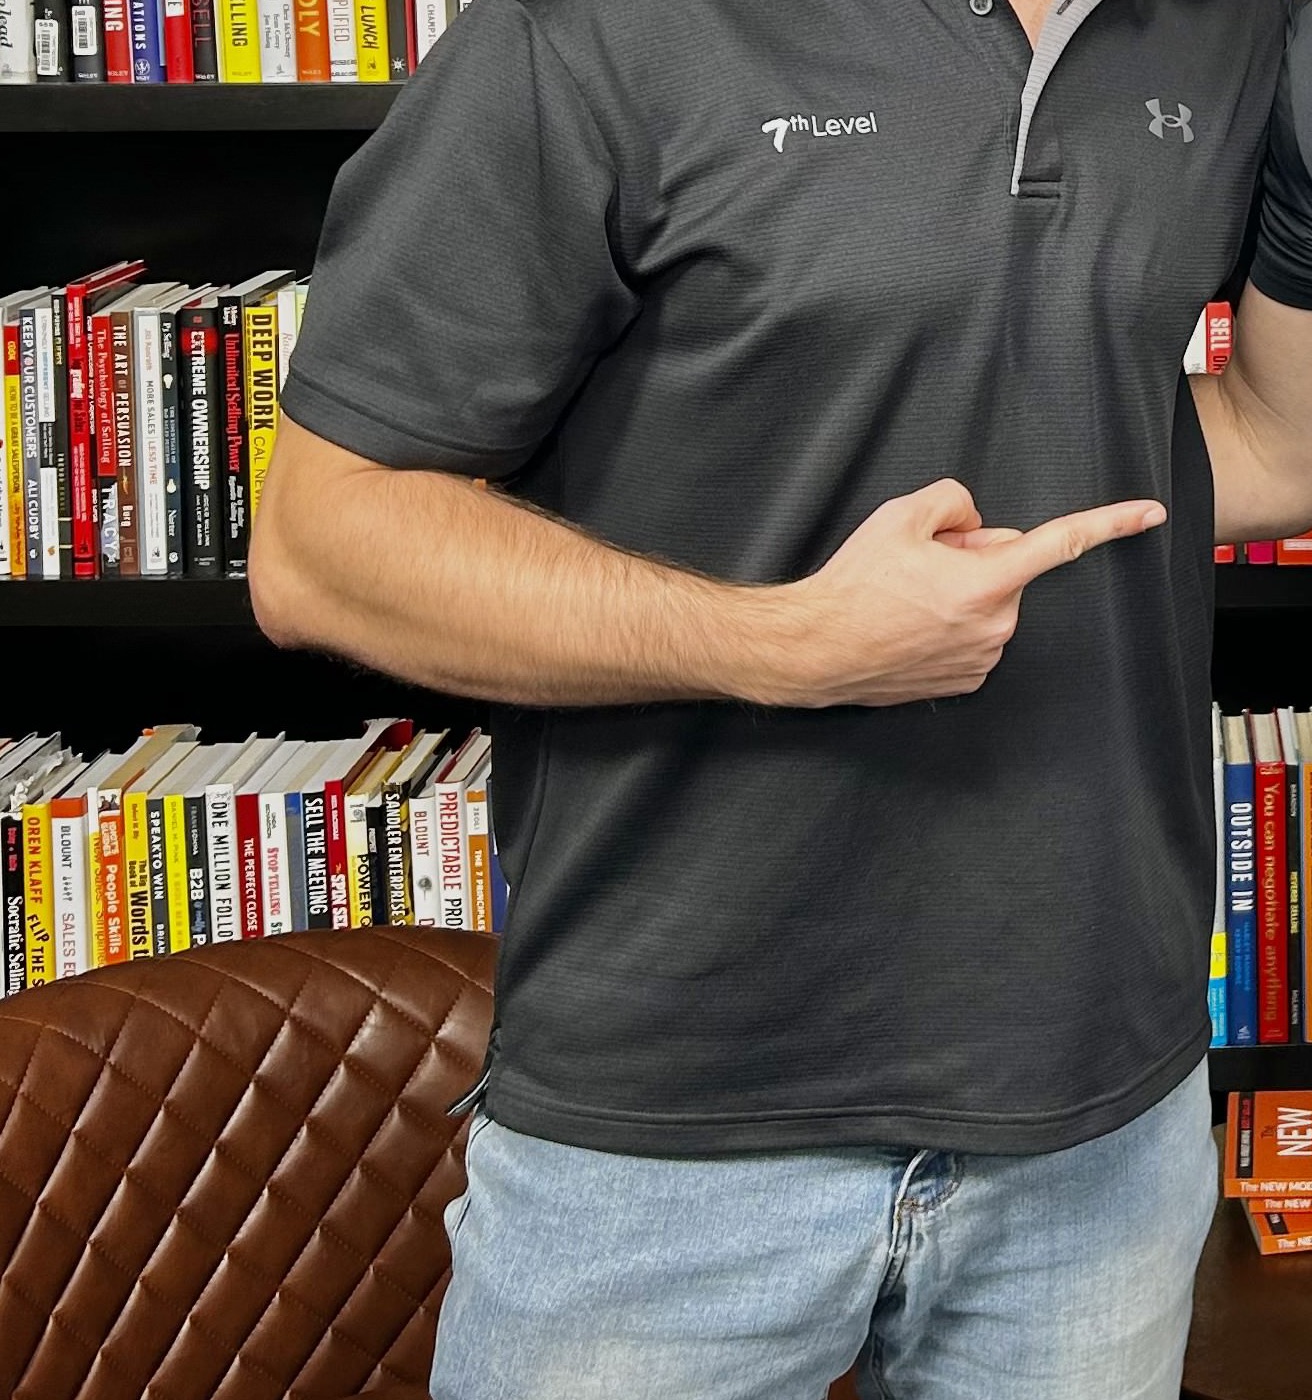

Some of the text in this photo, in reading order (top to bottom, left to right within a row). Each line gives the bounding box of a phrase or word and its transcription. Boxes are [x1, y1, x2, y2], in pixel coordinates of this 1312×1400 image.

[812, 112, 878, 137] Level
[251, 313, 274, 431] DEEP WORK
[1210, 317, 1229, 351] SELL
[113, 324, 131, 468] THE ART PERSUASION
[190, 331, 210, 491] EXTREME OWNERSHIP
[27, 817, 43, 904] OREN KLAFF
[61, 826, 72, 868] BLOUNT
[211, 802, 232, 891] ONE MILLION
[305, 798, 327, 914] SELL THE MEETING
[357, 854, 371, 904] POWER
[440, 792, 461, 891] PREDICTABLE
[1231, 803, 1253, 912] OUTSIDE IN
[62, 913, 75, 958] SALES
[103, 864, 122, 955] People Skills
[1260, 1182, 1285, 1192] NEW
